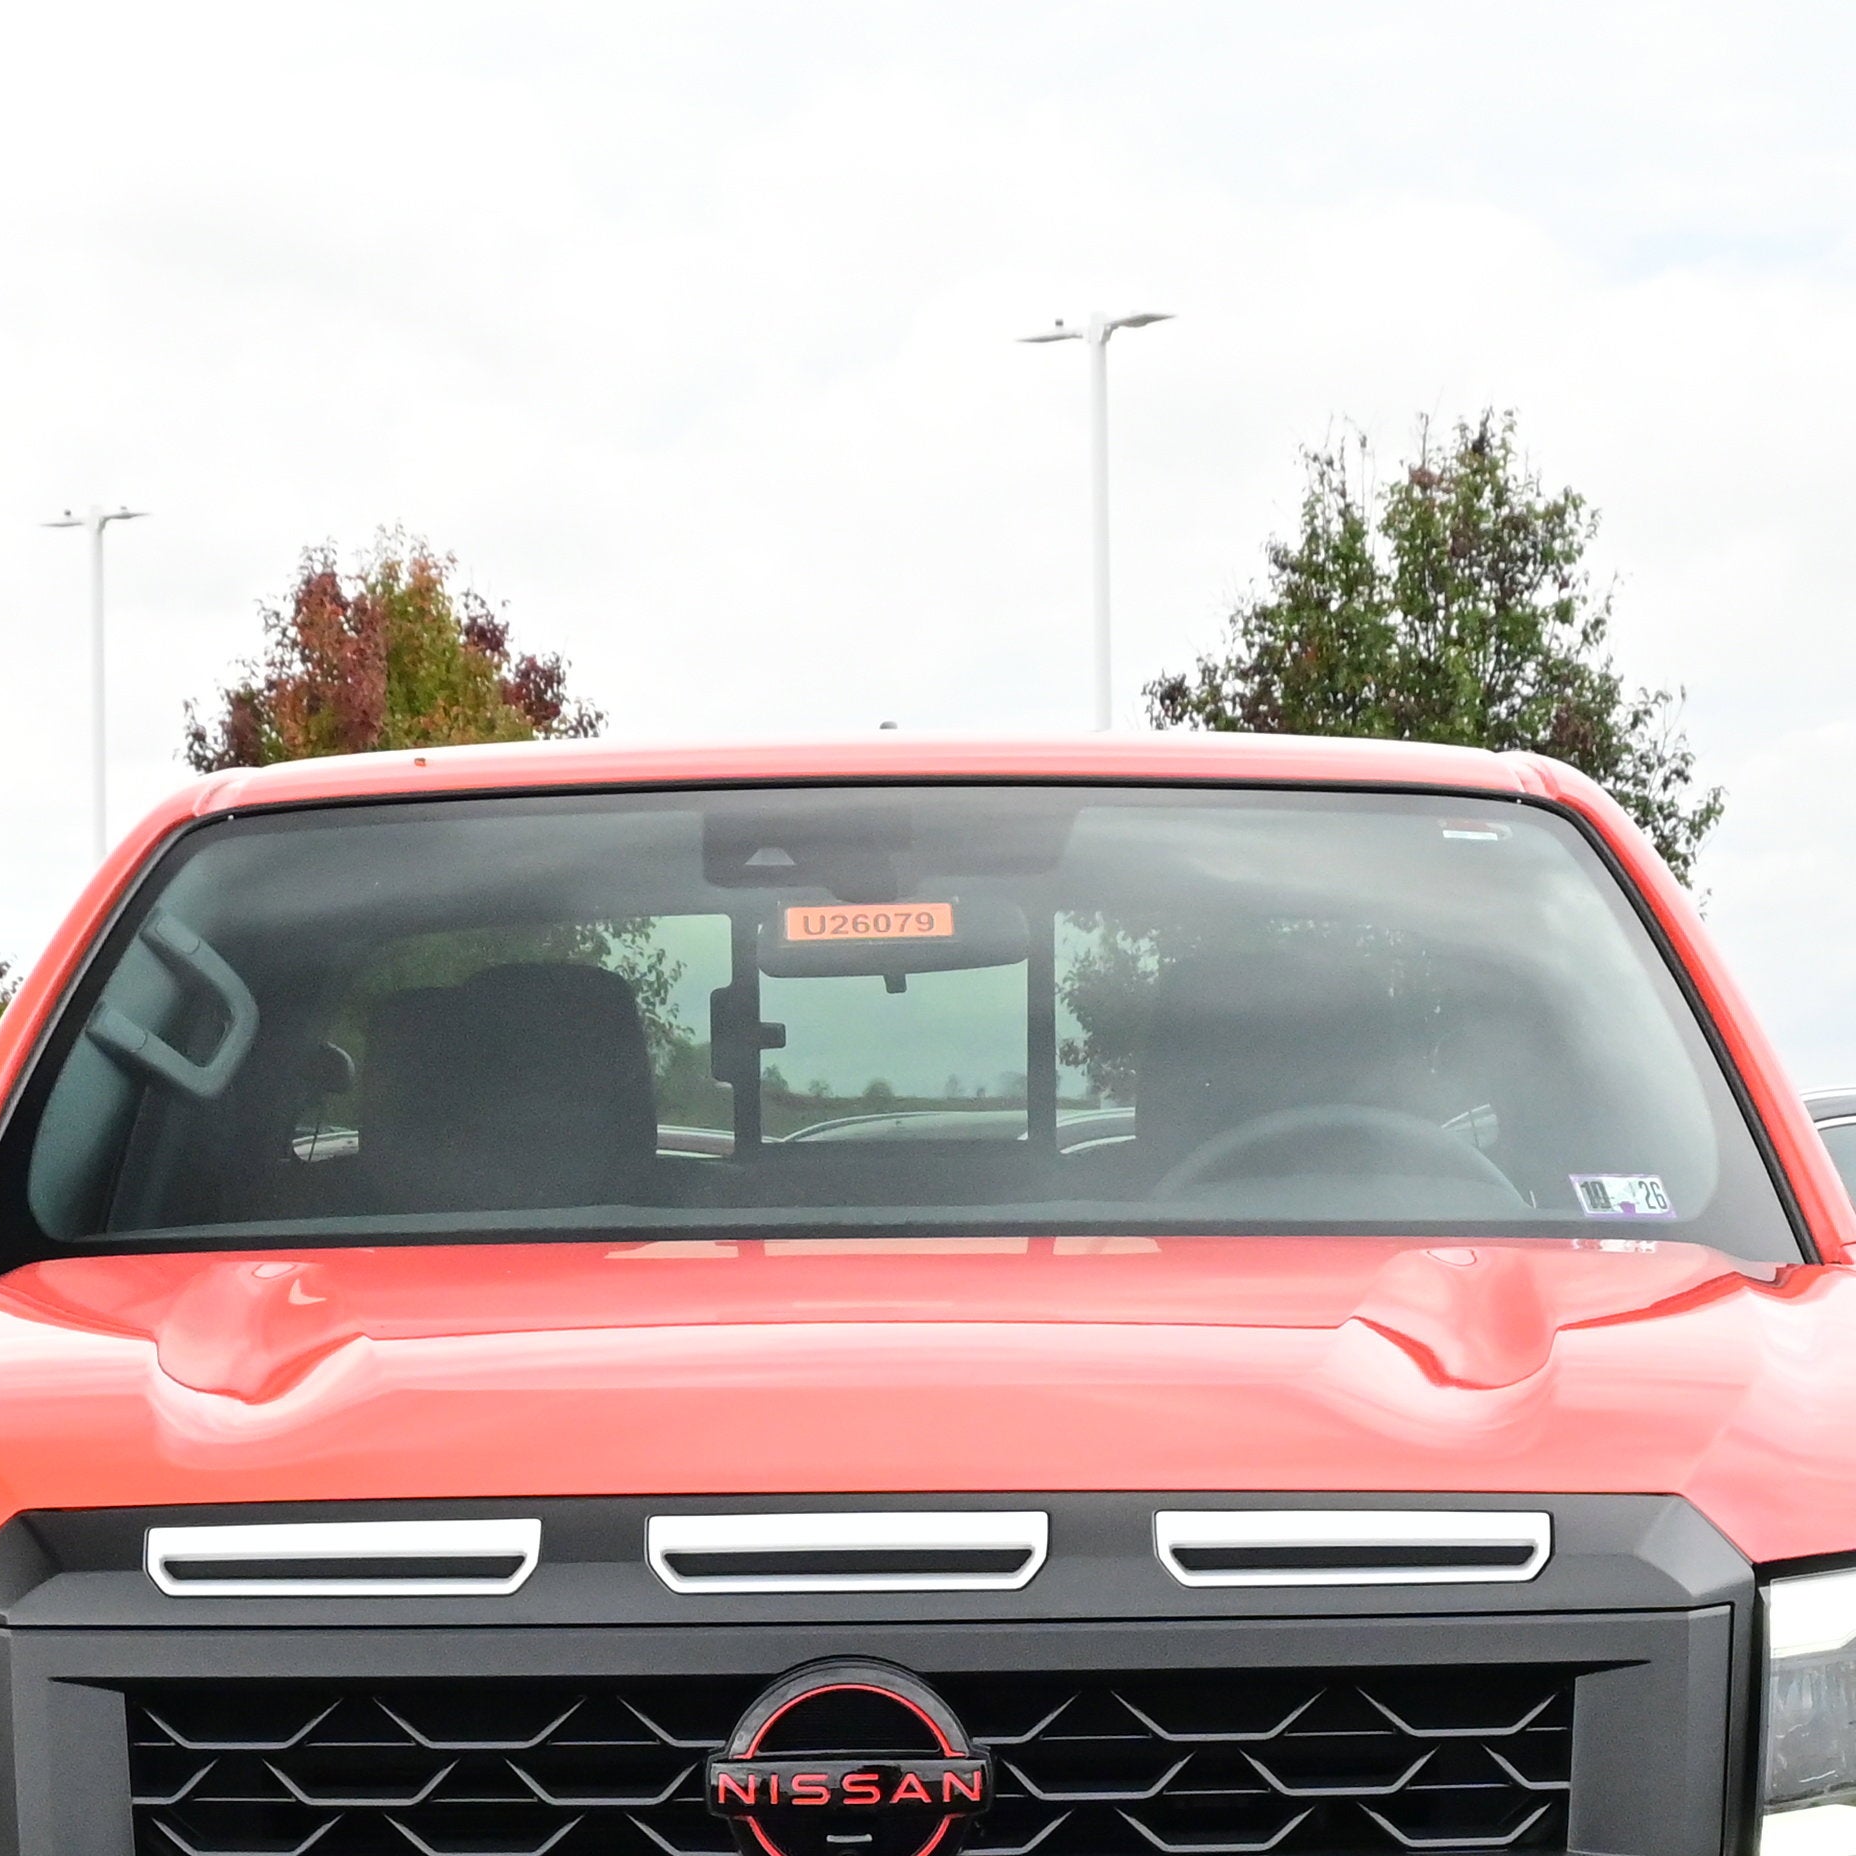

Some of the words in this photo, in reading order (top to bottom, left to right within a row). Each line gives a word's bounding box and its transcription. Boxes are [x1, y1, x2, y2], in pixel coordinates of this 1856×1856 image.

[802, 911, 935, 936] U26079
[1638, 1180, 1668, 1210] 26
[717, 1771, 982, 1805] NISSAN
